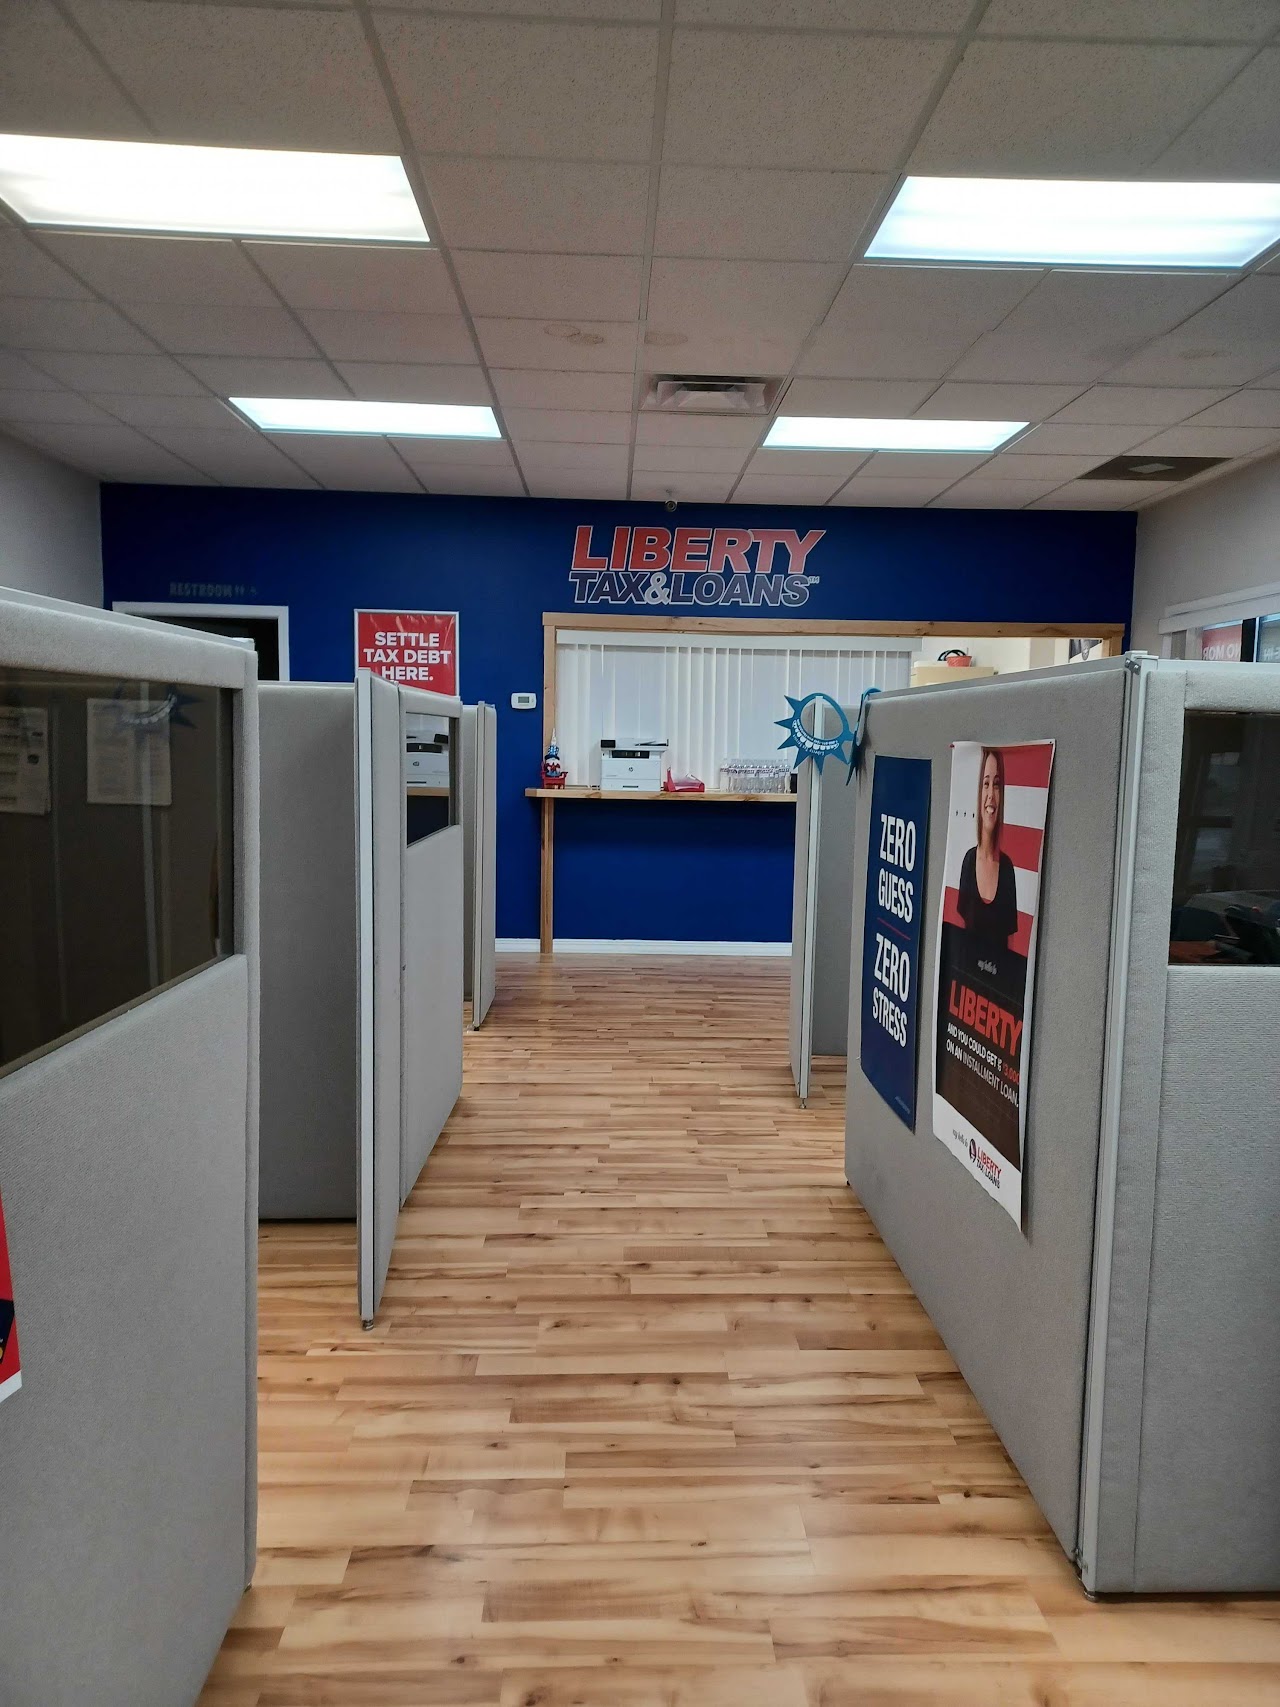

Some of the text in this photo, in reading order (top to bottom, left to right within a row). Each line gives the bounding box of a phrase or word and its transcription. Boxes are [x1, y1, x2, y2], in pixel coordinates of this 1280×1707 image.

[572, 526, 826, 574] LIBERTY
[363, 648, 452, 664] TAX DEBT
[374, 632, 440, 647] SETTLE
[382, 666, 434, 681] HERE.
[880, 814, 916, 872] ZERO
[878, 868, 914, 924] GUESS
[874, 932, 910, 1003] ZERO
[872, 986, 908, 1048] STRESS
[949, 980, 1022, 1056] LIBERTY
[947, 1022, 958, 1038] AND
[958, 1028, 968, 1046] YOU
[968, 1037, 986, 1058] COULD
[986, 1050, 998, 1067] GET
[946, 1038, 1018, 1108] ON AN INSTALLMENT LOAN.
[978, 1146, 1002, 1180] LIBERTY
